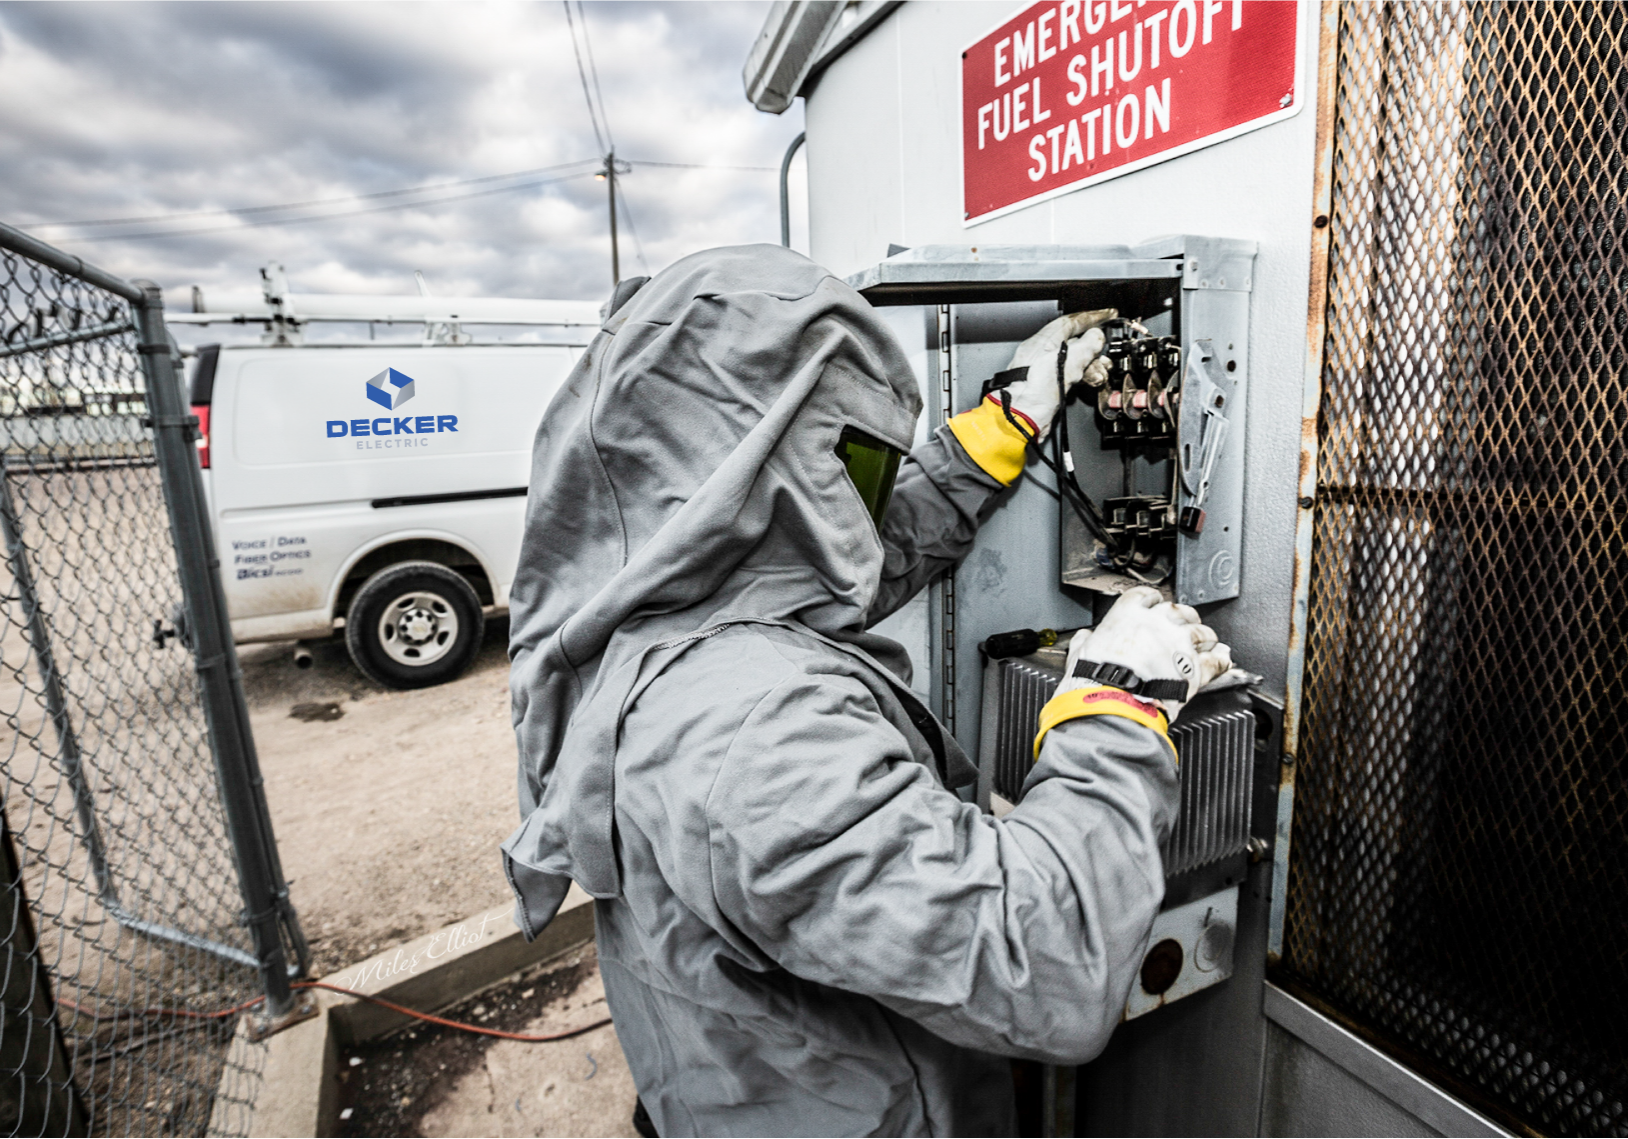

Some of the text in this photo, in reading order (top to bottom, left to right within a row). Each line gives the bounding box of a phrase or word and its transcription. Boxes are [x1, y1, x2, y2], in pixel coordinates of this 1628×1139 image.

[994, 0, 1147, 87] EMERG
[977, 77, 1051, 150] FUEL
[1027, 78, 1171, 182] STATION
[326, 414, 459, 438] DECKER
[356, 437, 429, 450] ELECTRIC
